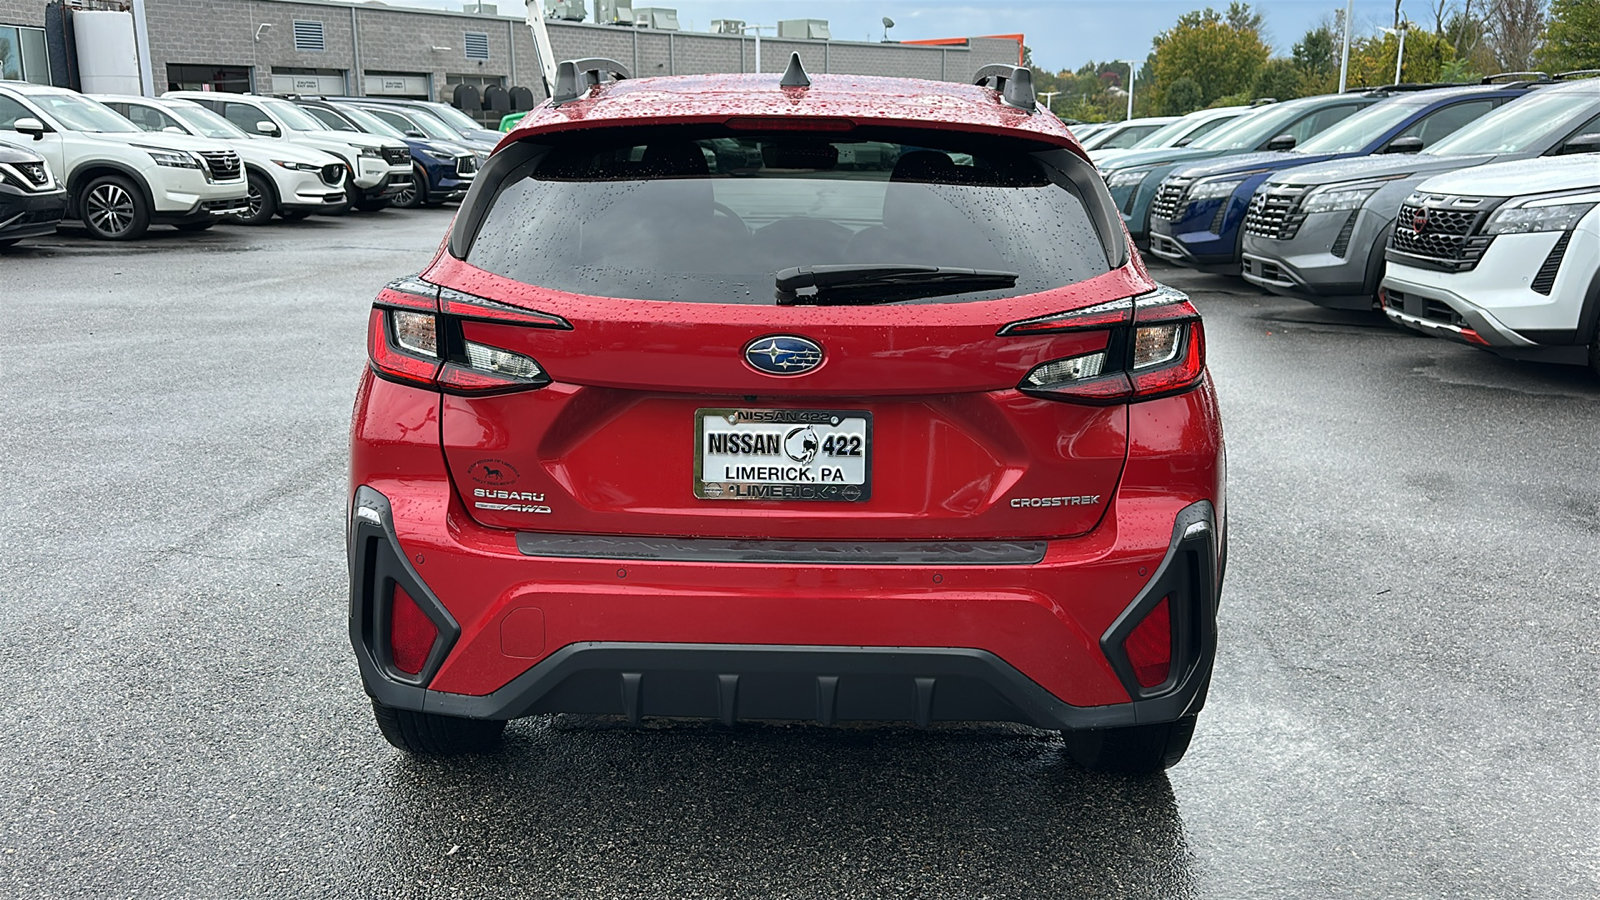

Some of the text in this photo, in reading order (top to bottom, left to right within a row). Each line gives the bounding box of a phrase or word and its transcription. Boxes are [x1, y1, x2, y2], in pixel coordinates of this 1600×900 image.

[737, 411, 830, 421] NISSAN 422
[708, 433, 862, 457] NISSAN 422
[725, 466, 844, 482] LIMERICK, PA
[474, 488, 544, 501] SUBARU
[735, 485, 830, 499] LIMERICK
[1010, 495, 1100, 507] CROSSTREK
[503, 504, 551, 513] AWD
